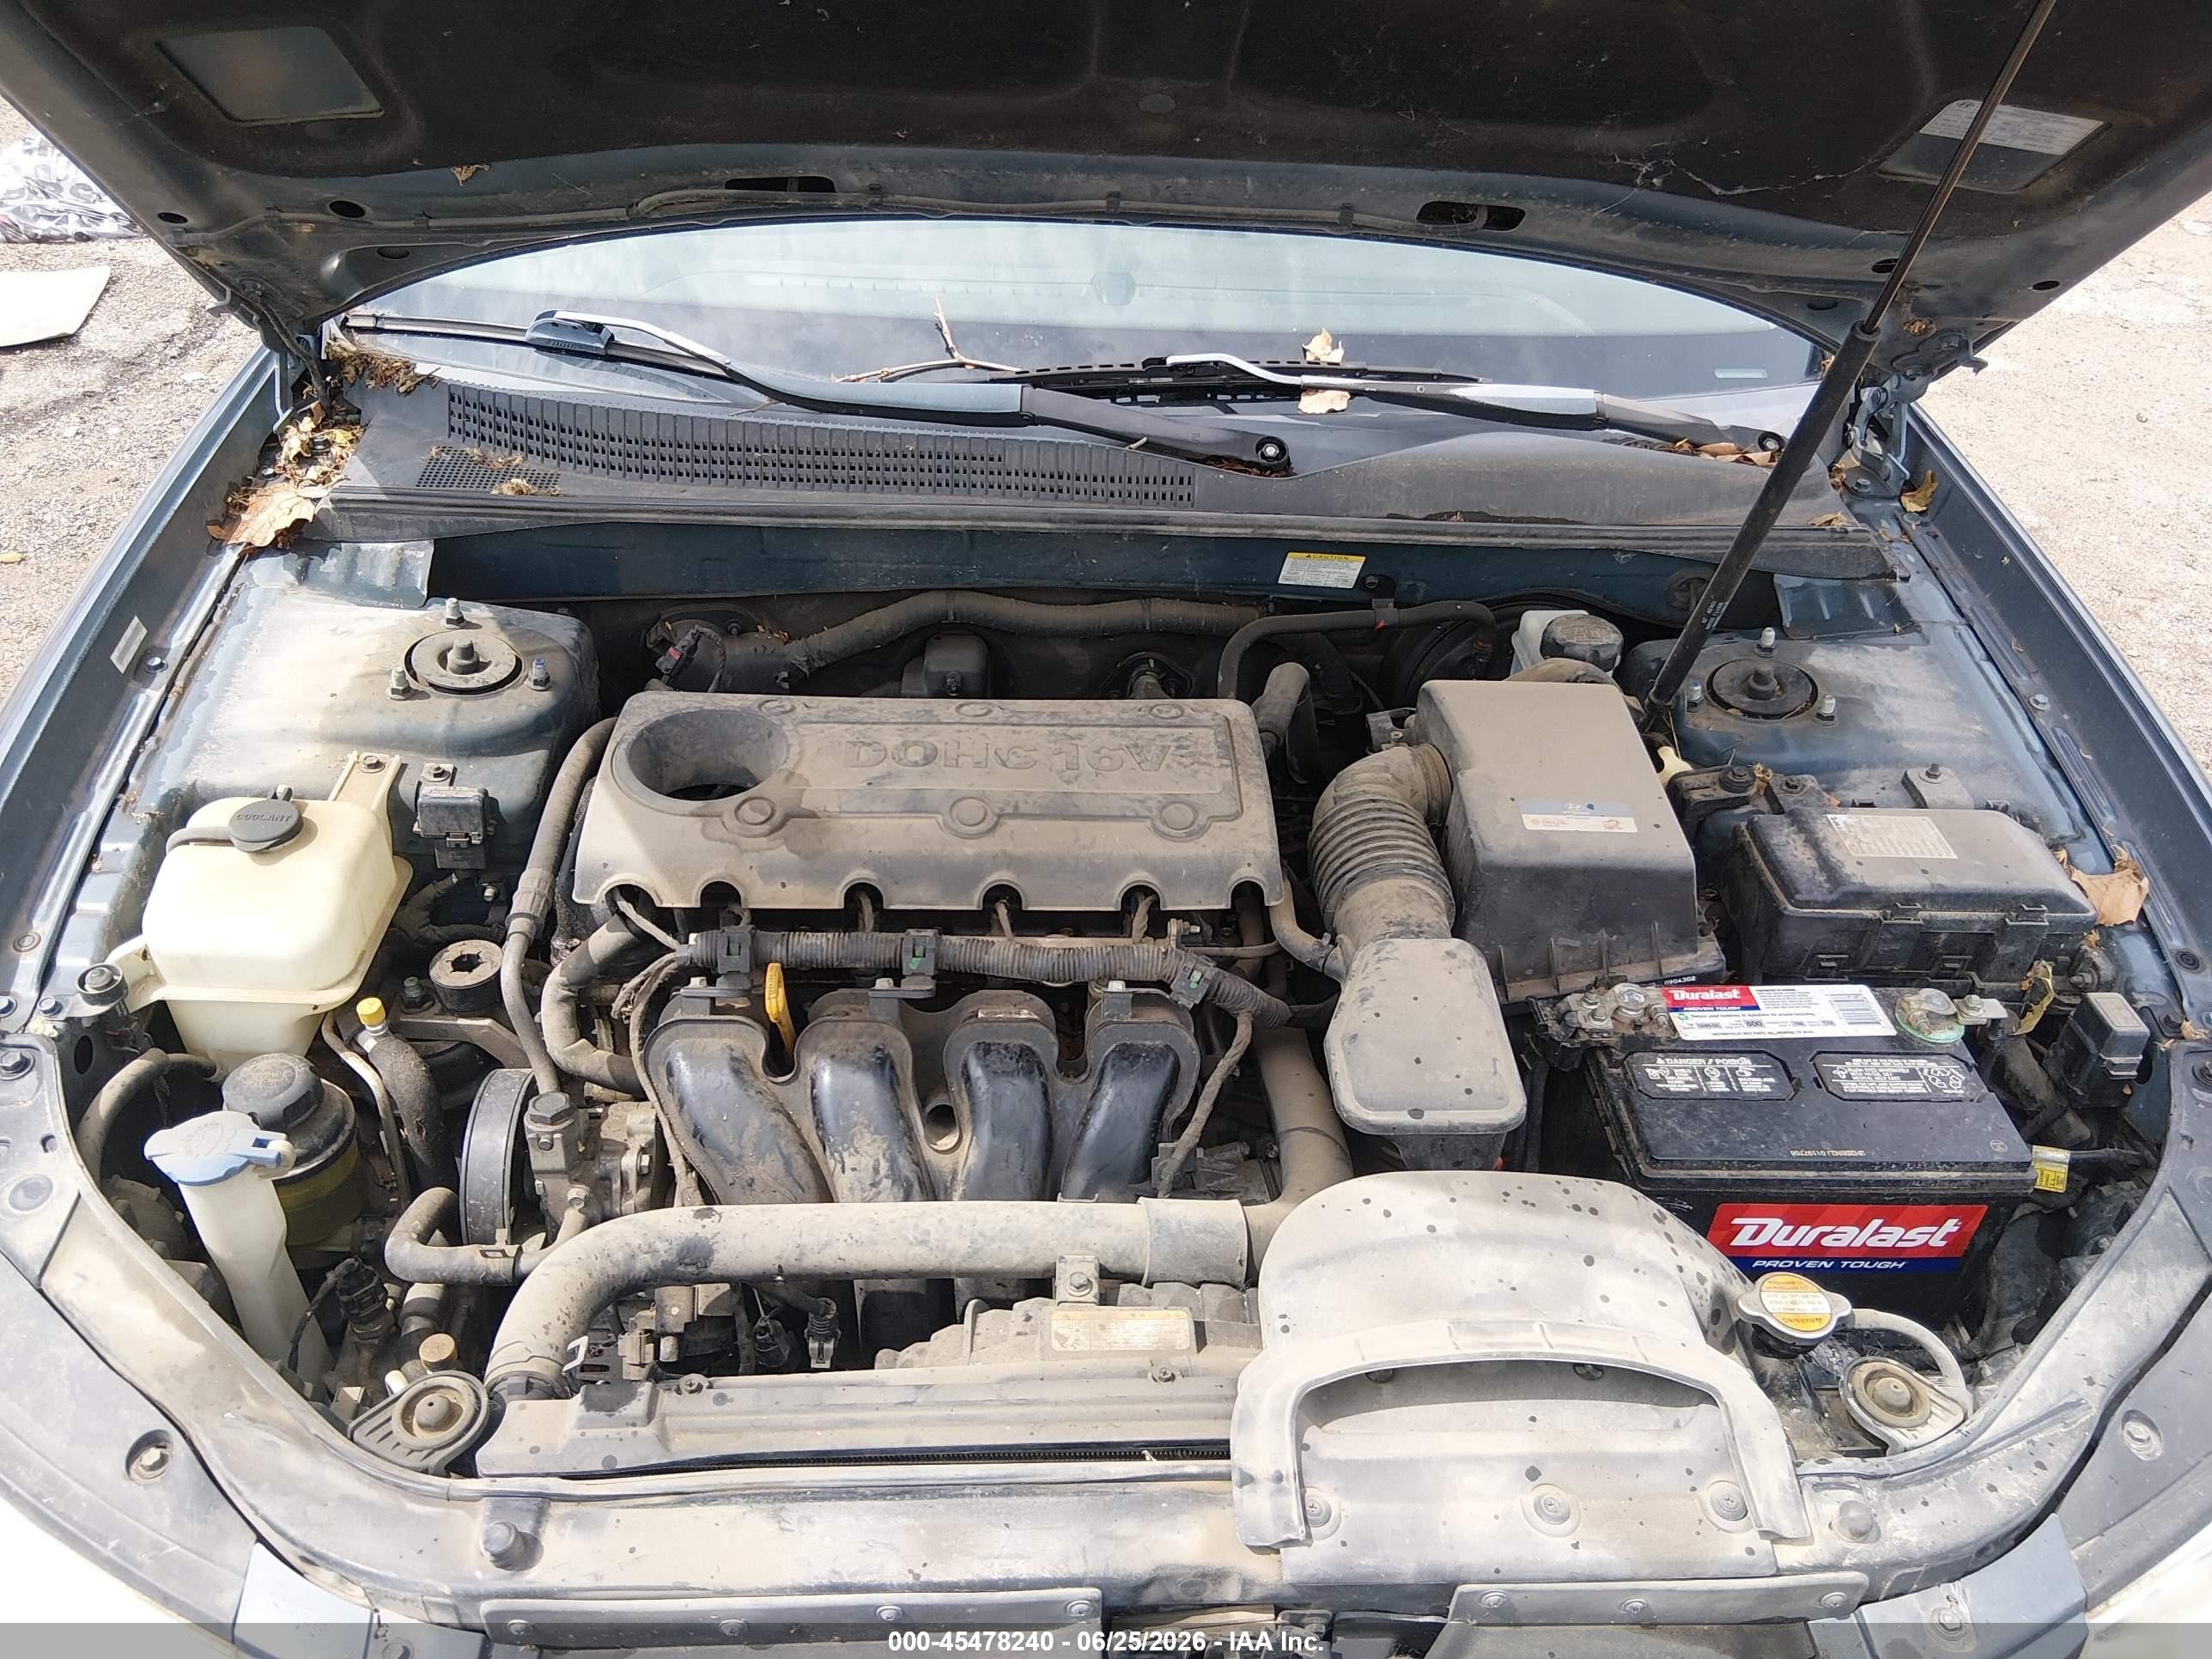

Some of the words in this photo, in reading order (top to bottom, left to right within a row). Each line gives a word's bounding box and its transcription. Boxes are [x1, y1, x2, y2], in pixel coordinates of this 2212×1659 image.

[845, 740, 1037, 770] DOHC
[1668, 988, 1741, 1000] Duralast
[1729, 1218, 1960, 1247] Duralast
[1752, 1260, 1832, 1268] PROVEN
[1840, 1261, 1905, 1269] TOUGH
